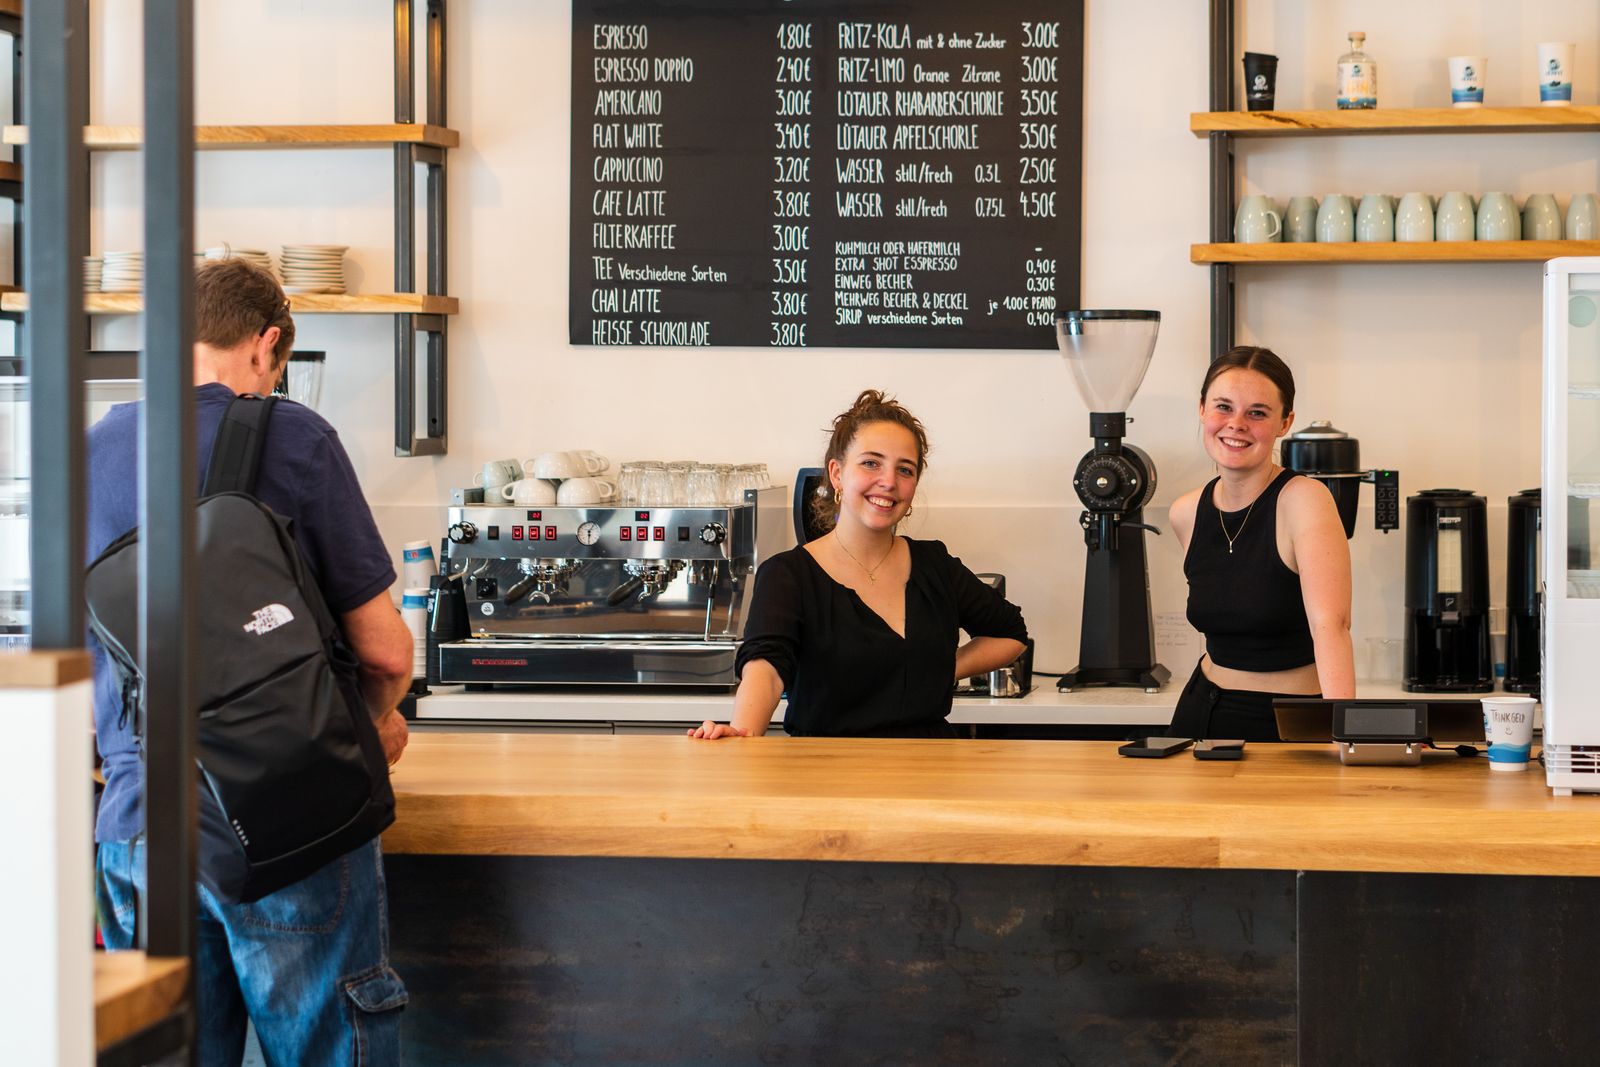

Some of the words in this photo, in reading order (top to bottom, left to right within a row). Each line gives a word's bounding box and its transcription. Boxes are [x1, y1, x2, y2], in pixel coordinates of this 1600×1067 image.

[594, 25, 647, 49] ESPRESSO
[839, 23, 911, 49] FRITZ-KOLA
[917, 35, 933, 49] mit
[937, 33, 944, 48] &
[949, 33, 972, 48] ohne
[975, 33, 1006, 48] Zucker
[595, 58, 648, 82] ESPRESSO
[655, 57, 693, 82] DOPPIO
[839, 57, 904, 82] FRITZ-LIMO
[914, 64, 949, 83] Orange
[962, 64, 1000, 82] Zitrone
[595, 90, 661, 115] AMERICANO
[896, 91, 1003, 116] RHABARBERSCHORLE
[594, 123, 620, 148] FLAT
[624, 123, 662, 148] WHITE
[893, 125, 979, 149] APFELSCHORLE
[594, 156, 662, 182] CAPPUCCINO
[836, 158, 884, 183] WASSER
[896, 162, 952, 183] still/frech
[593, 190, 623, 216] CAFE
[627, 190, 666, 216] LATTE
[837, 192, 883, 217] WASSER
[896, 197, 947, 217] still/frech
[594, 223, 676, 249] FILTERKAFFEE
[836, 242, 880, 255] KUHMILCH
[883, 242, 905, 254] ODER
[908, 241, 960, 256] HAFERMILCH
[592, 256, 613, 279] TEE
[618, 263, 686, 281] Verschiedene
[692, 265, 726, 282] Sorten
[836, 257, 864, 271] EXTRA
[873, 256, 898, 271] SHOT
[904, 256, 957, 271] ESSPRESSO
[835, 274, 871, 289] EINWEG
[876, 274, 913, 289] BECHER
[592, 288, 618, 312] CHAI
[623, 289, 661, 313] LATTE
[835, 291, 879, 307] MEHRWEG
[884, 292, 919, 308] BECHER
[923, 292, 931, 308] &
[934, 293, 968, 310] DECKEL
[987, 300, 998, 315] je
[1032, 296, 1056, 309] PFAND
[835, 308, 862, 325] SIRUP
[867, 311, 927, 324] verschiedene
[931, 312, 962, 325] Sorten
[593, 320, 633, 344] HEISSE
[640, 321, 710, 346] SCHOKOLADE
